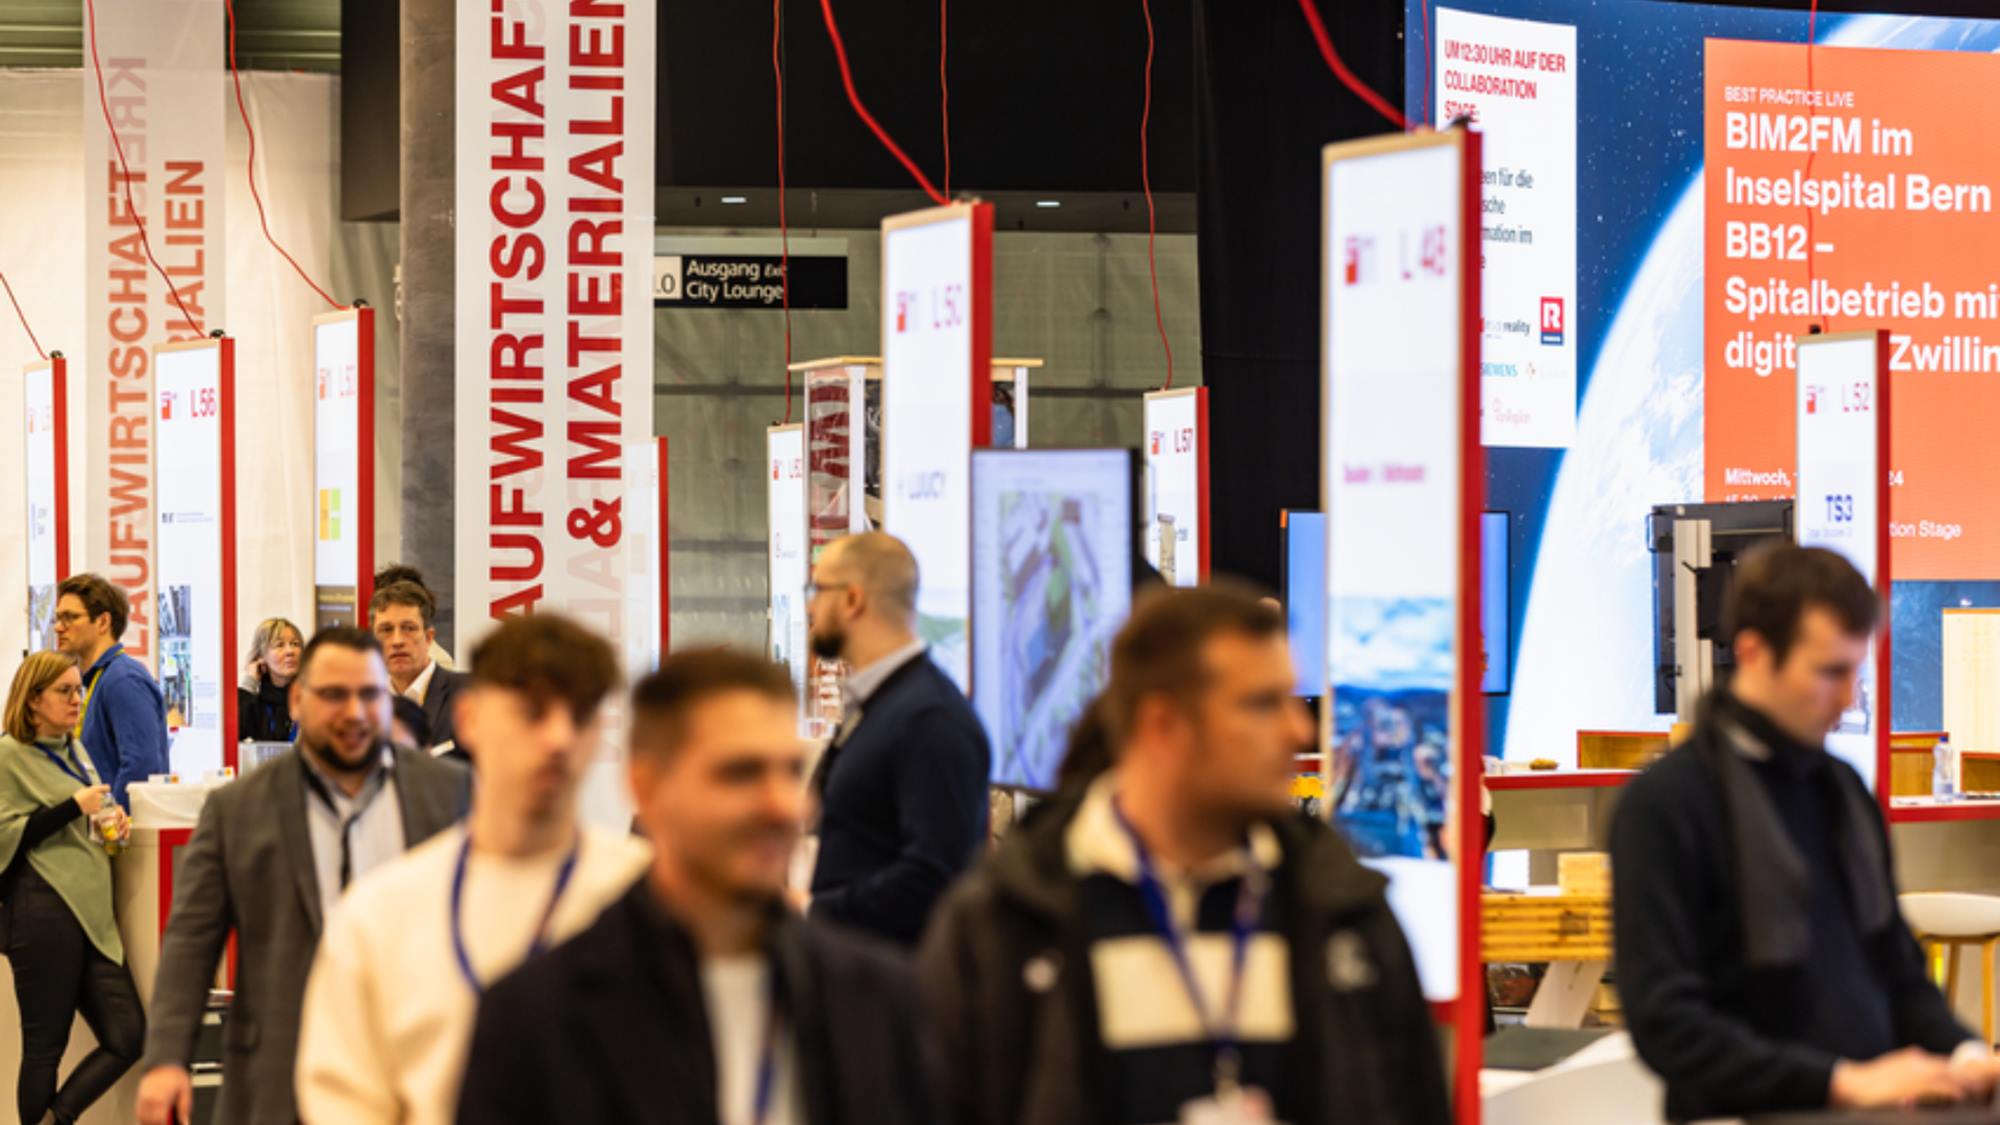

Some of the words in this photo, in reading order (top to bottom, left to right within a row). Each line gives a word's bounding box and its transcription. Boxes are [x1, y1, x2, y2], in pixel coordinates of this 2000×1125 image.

[1444, 39, 1460, 59] UM
[1461, 43, 1486, 64] 12:30
[1489, 45, 1511, 67] UHR
[1513, 49, 1538, 69] AUF
[1539, 53, 1566, 73] DER
[1444, 70, 1537, 99] COLLABORATION
[1724, 86, 1757, 103] BEST
[1759, 88, 1823, 107] PRACTICE
[1825, 91, 1854, 108] LIVE
[1726, 111, 1862, 154] BIM2FM
[1872, 118, 1913, 156] im
[1726, 166, 1895, 216] Inselspital
[1905, 175, 1991, 213] Bern
[165, 161, 204, 342] IALIEN
[1726, 221, 1808, 260] BB12
[686, 259, 760, 281] Ausgang
[686, 281, 719, 303] City
[723, 282, 784, 304] Lounge
[1725, 276, 1945, 321] Spitalbetrieb
[489, 0, 547, 622] AUFWIRTSCHAF
[190, 387, 217, 418] L56
[1724, 467, 1791, 488] Mittwoch,
[567, 497, 622, 548] &
[1919, 519, 1962, 540] Stage
